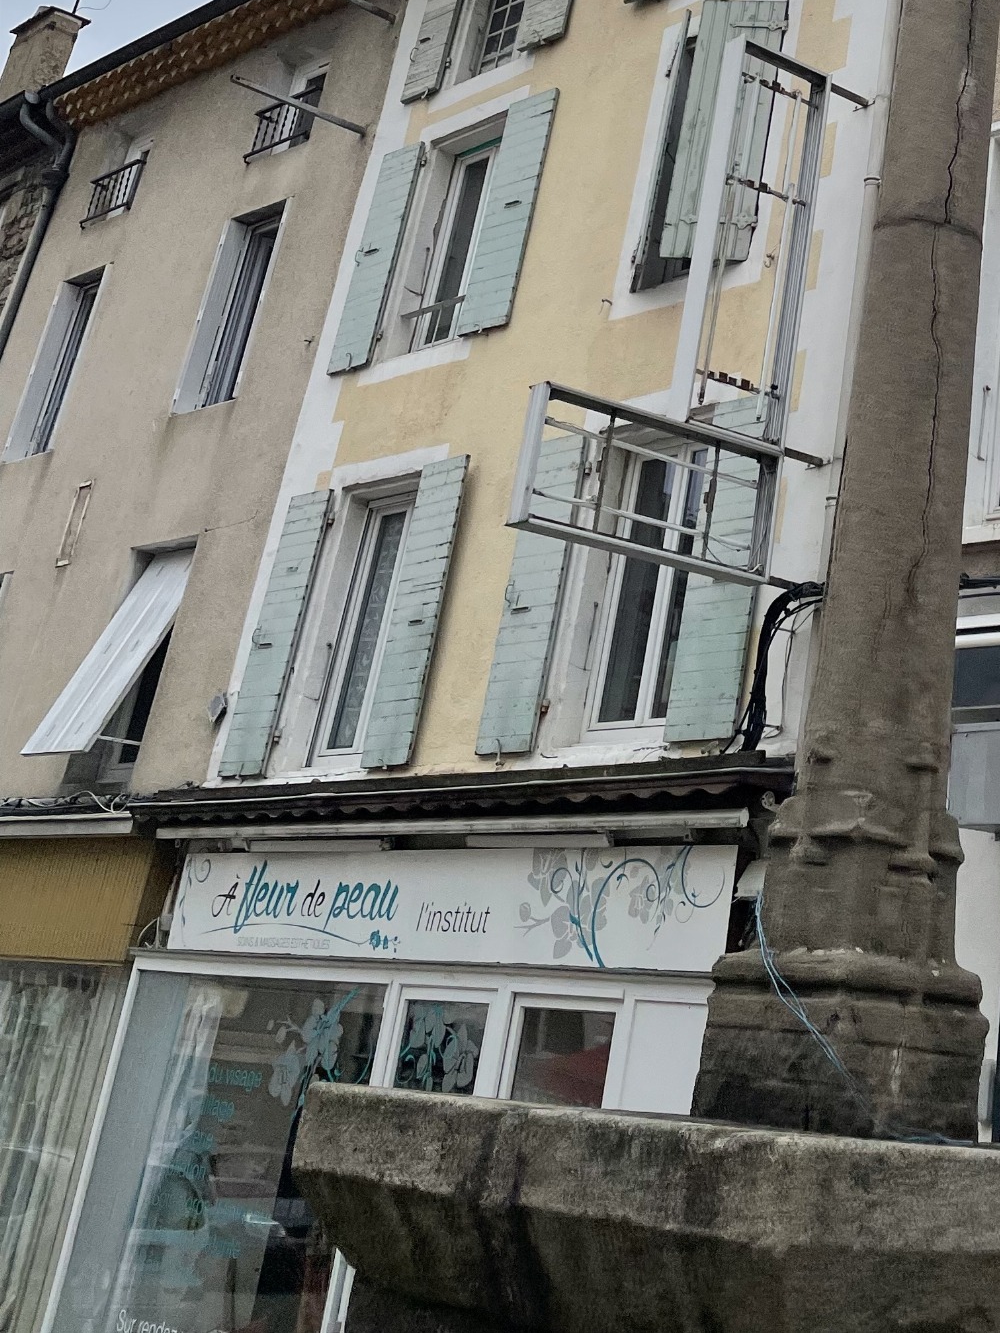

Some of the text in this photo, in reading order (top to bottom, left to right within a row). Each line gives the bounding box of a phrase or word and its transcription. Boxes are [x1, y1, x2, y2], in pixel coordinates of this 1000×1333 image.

[233, 859, 300, 934] fleur
[300, 879, 326, 918] de
[323, 879, 400, 932] peau
[415, 901, 491, 934] l'institut
[116, 1309, 137, 1333] Sur
